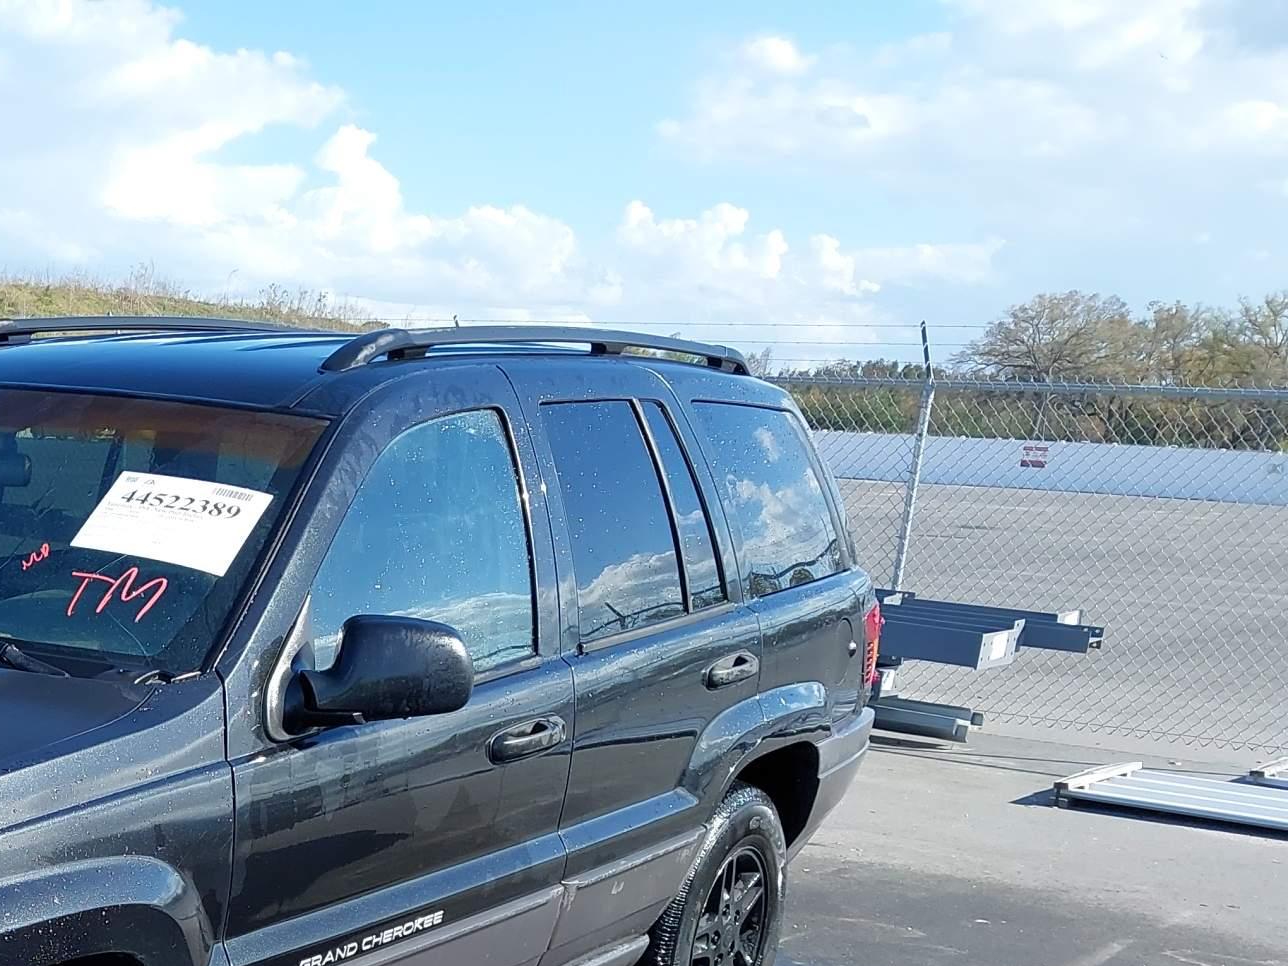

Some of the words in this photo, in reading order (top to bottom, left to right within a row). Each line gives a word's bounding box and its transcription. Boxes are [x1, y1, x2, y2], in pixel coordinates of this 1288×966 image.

[120, 489, 242, 519] 44522389
[66, 567, 169, 624] TM
[361, 910, 445, 951] CHEROKEE
